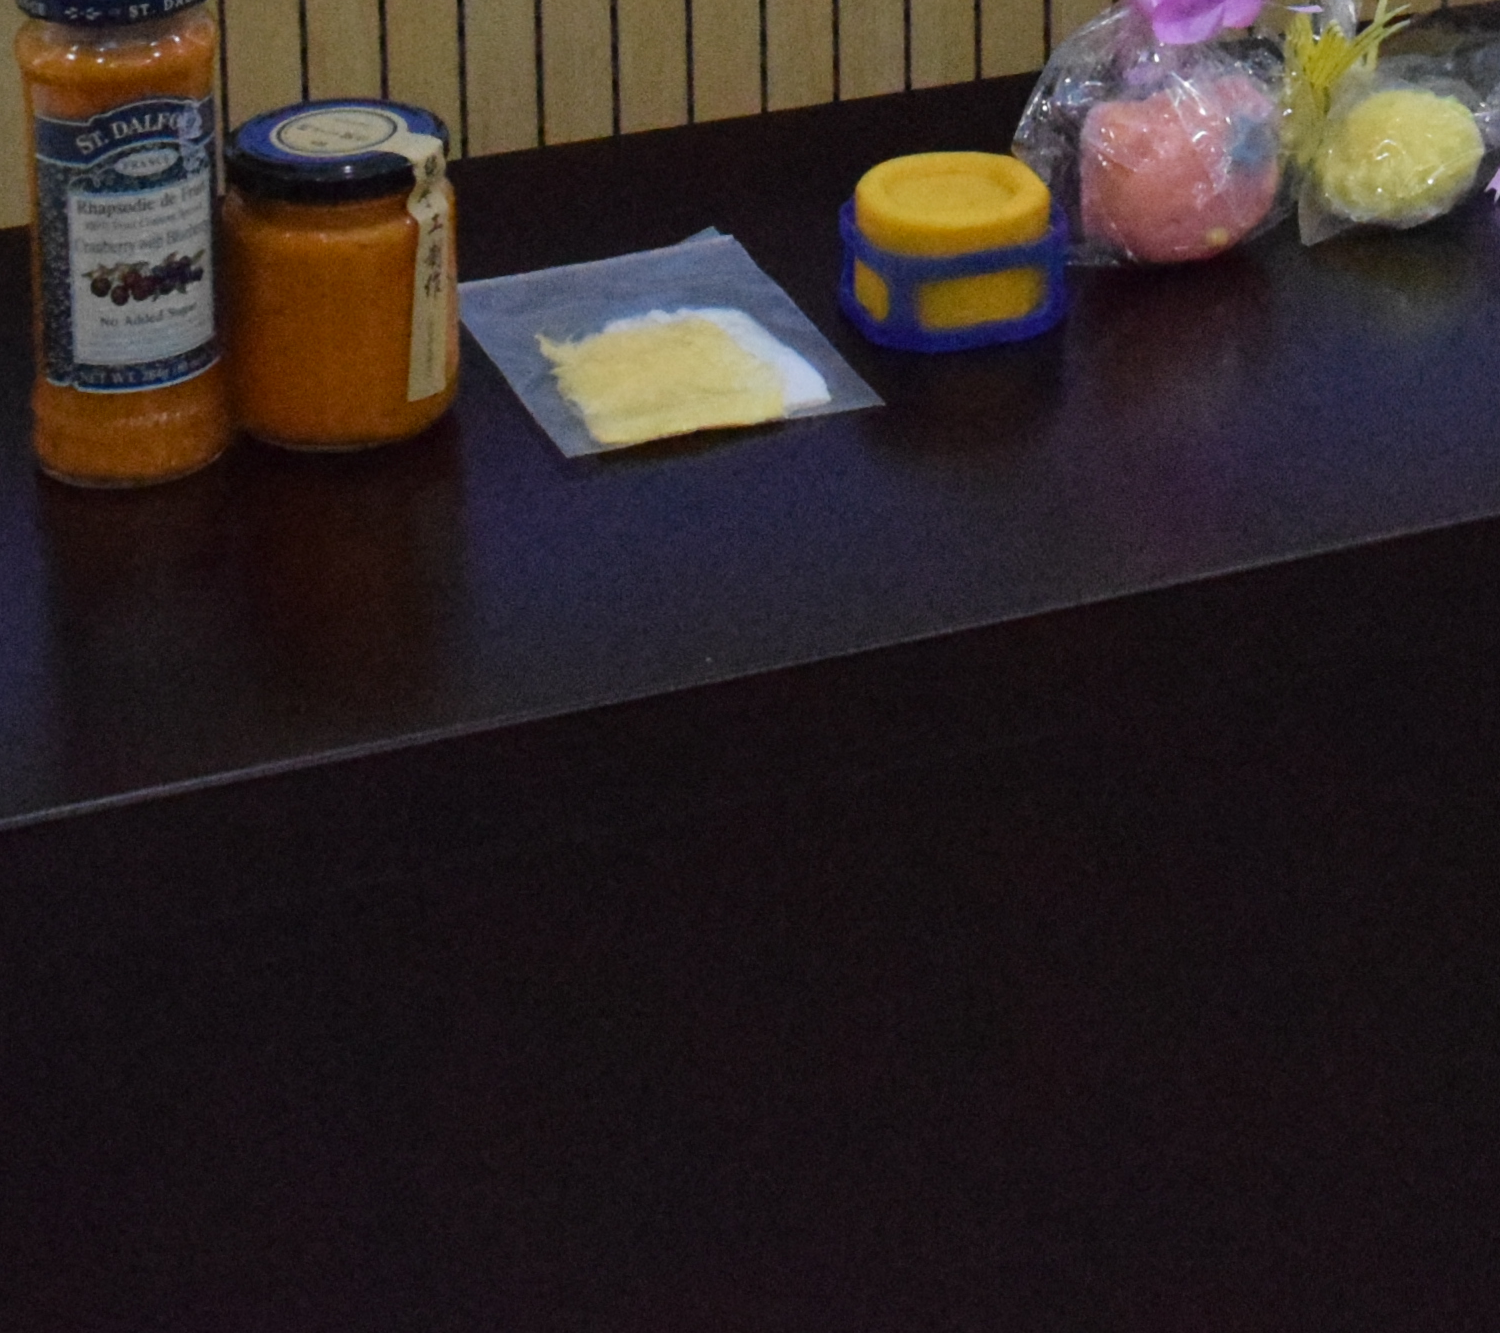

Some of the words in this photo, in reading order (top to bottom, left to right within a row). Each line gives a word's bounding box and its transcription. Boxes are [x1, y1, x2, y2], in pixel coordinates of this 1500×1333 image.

[76, 198, 154, 217] Rhapsodie
[160, 192, 177, 208] de
[125, 309, 164, 326] Added
